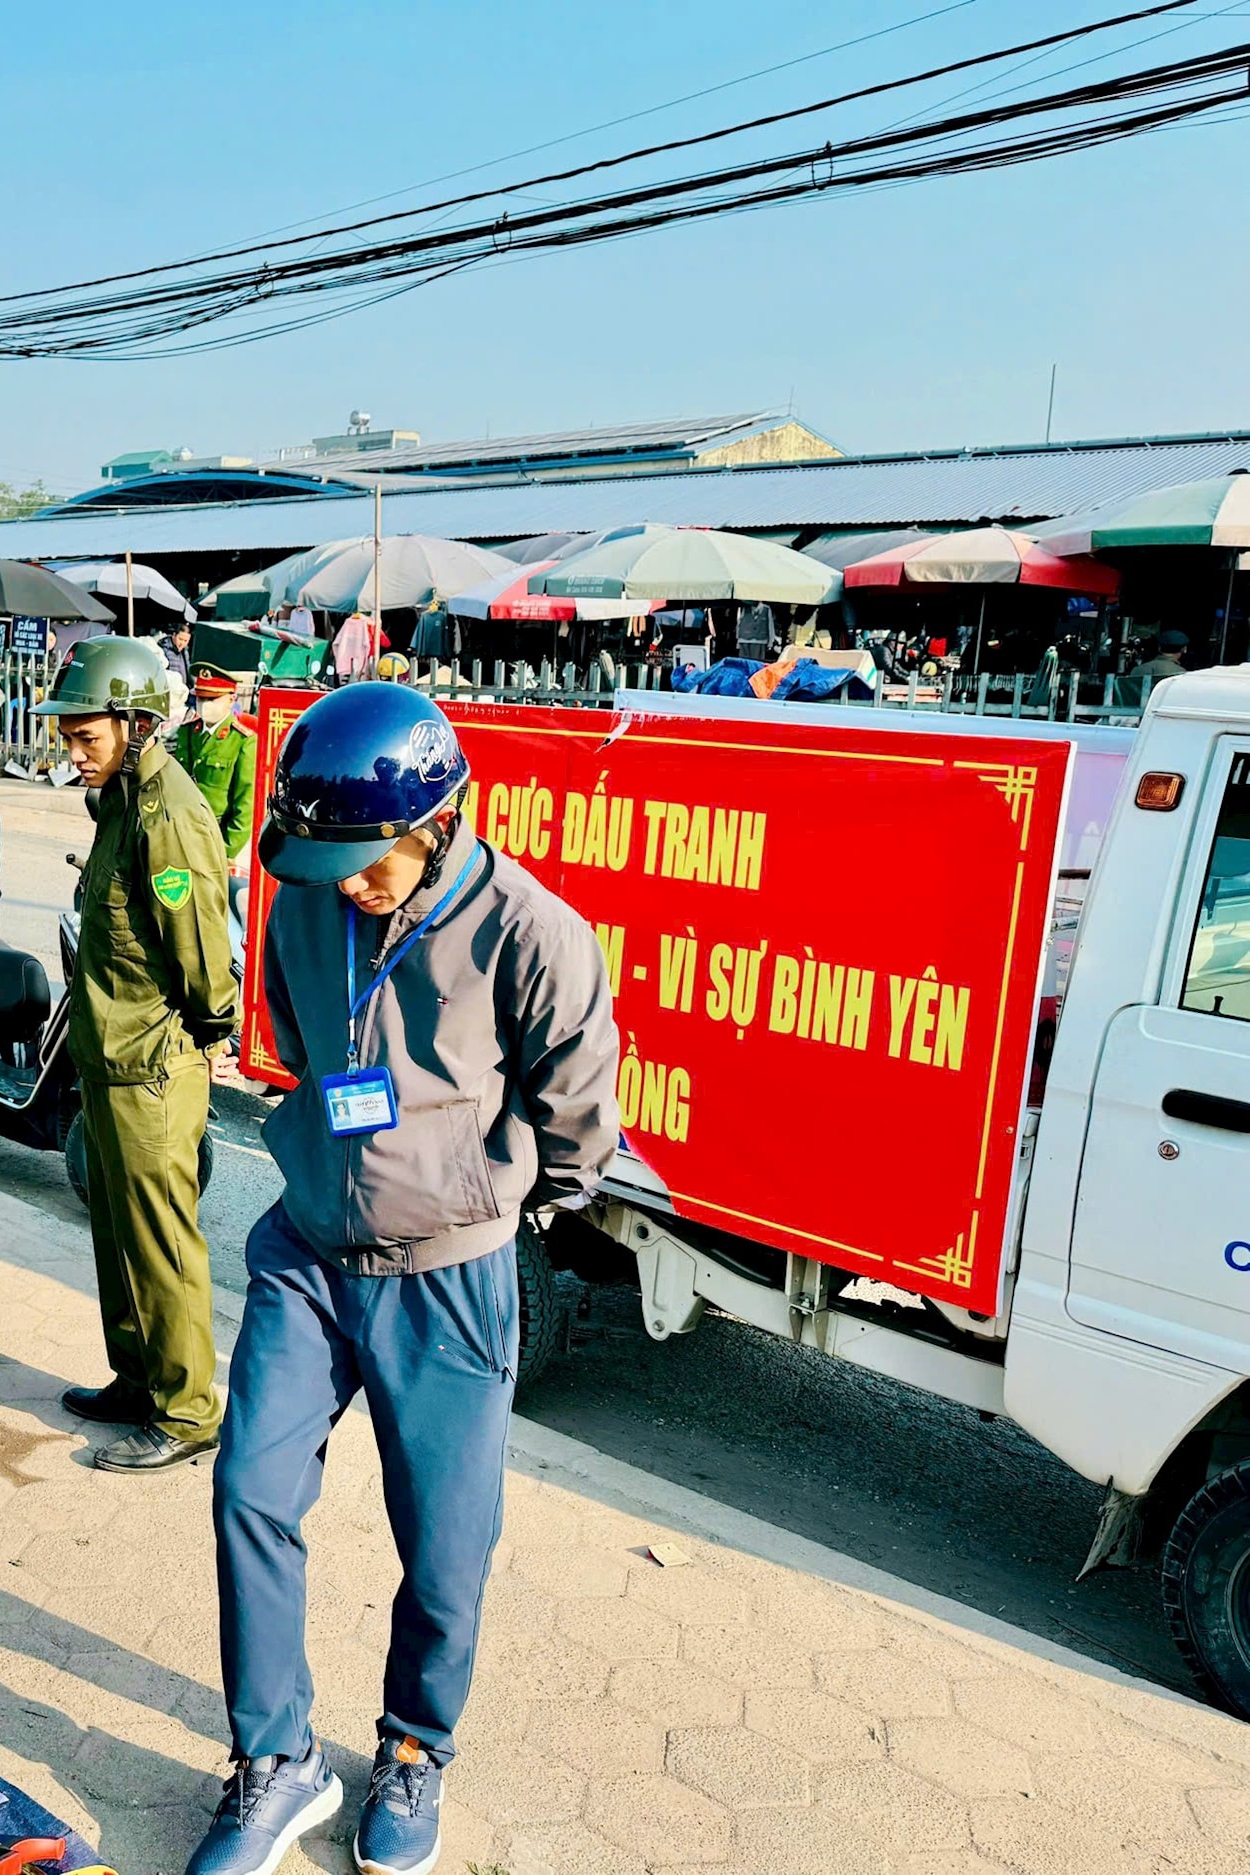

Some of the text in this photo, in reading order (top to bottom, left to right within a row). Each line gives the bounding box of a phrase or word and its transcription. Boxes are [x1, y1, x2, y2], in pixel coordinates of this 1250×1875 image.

[561, 770, 634, 872] ĐẤU
[643, 800, 767, 891] TRANH
[659, 926, 698, 1014] VÌ
[705, 939, 768, 1041] SỰ
[768, 946, 876, 1052] BÌNH
[888, 965, 971, 1072] YÊN
[617, 1031, 691, 1144] ỒNG
